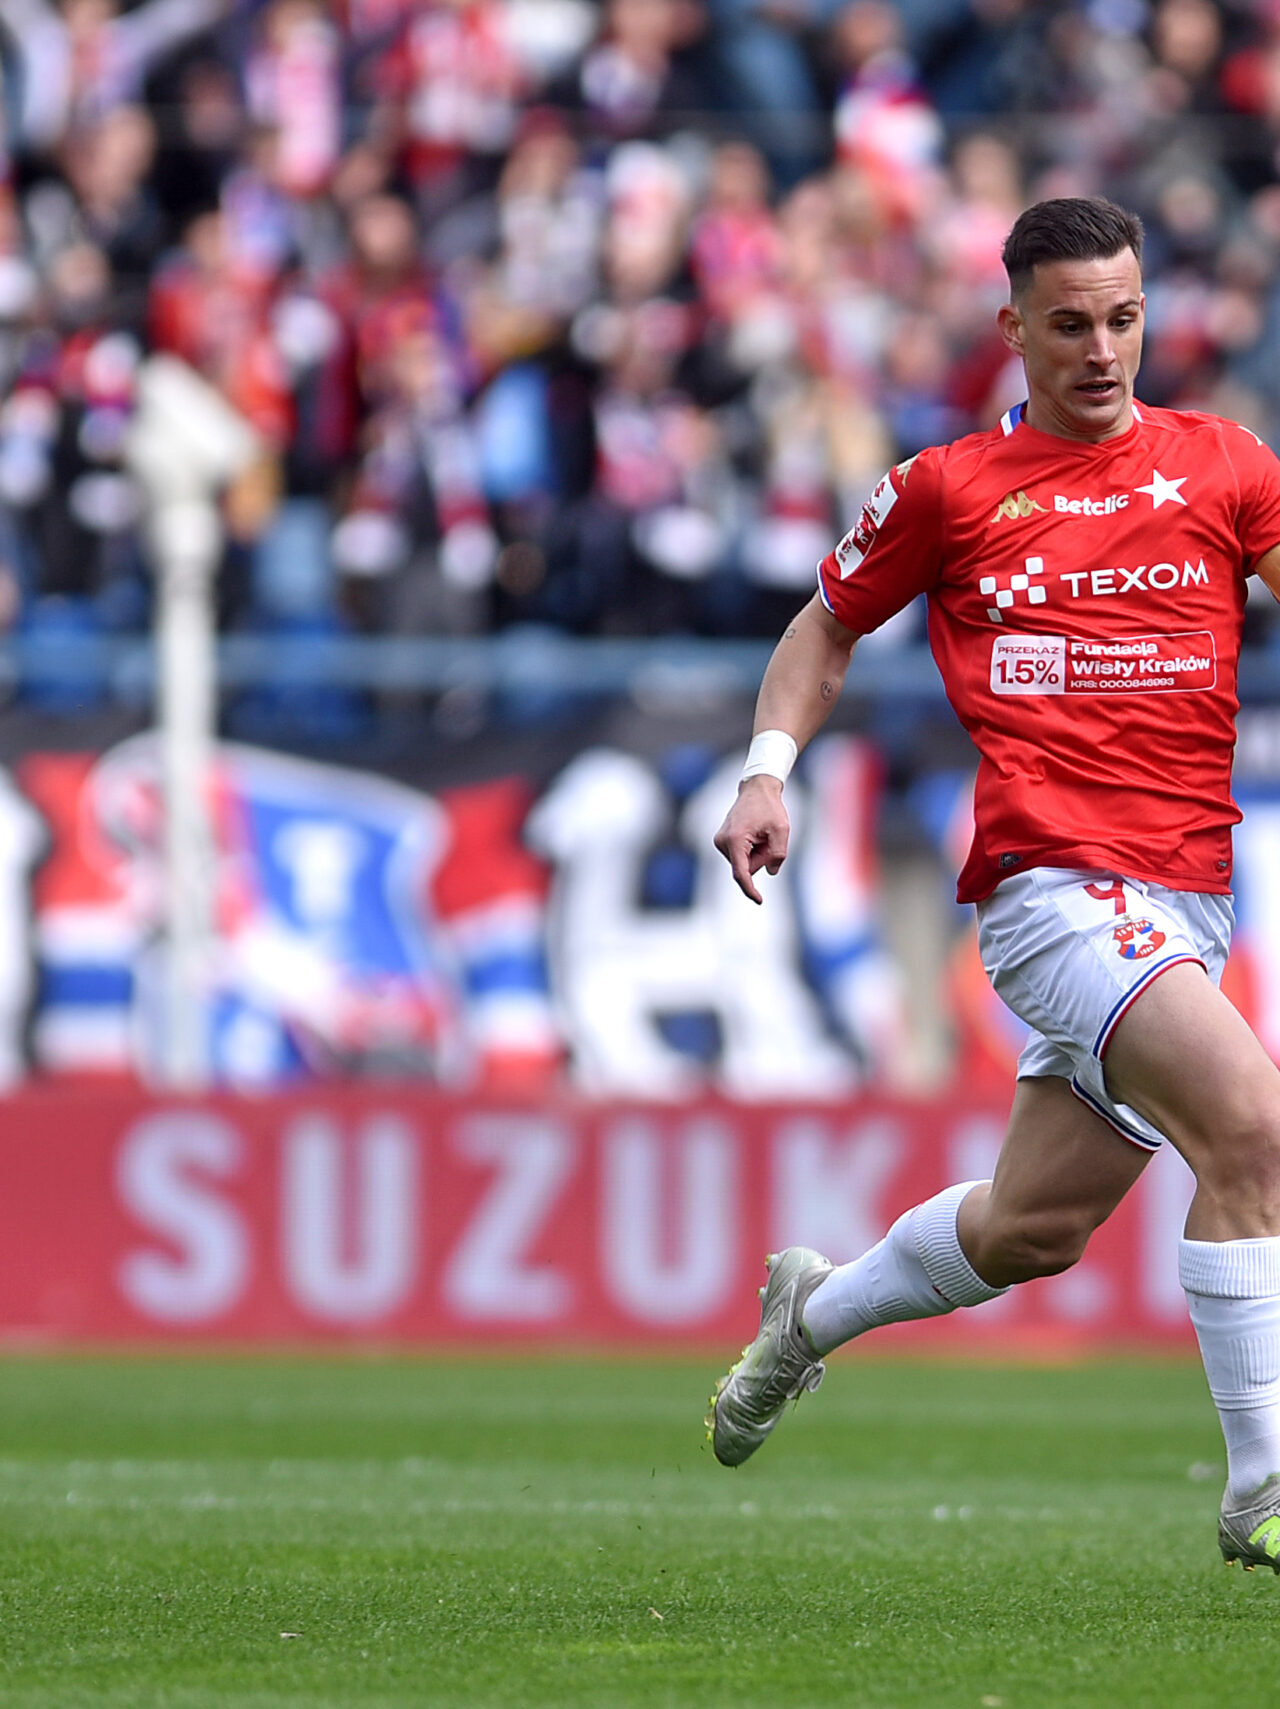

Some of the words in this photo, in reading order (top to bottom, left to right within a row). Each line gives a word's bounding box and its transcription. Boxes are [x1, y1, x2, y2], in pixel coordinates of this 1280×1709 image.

[1054, 494, 1129, 516] Betclic
[1060, 558, 1209, 598] TEXOM
[1071, 642, 1158, 656] Fundacja
[996, 659, 1059, 685] 1.5%
[1072, 660, 1136, 677] Wisły
[1139, 655, 1210, 673] Kraków
